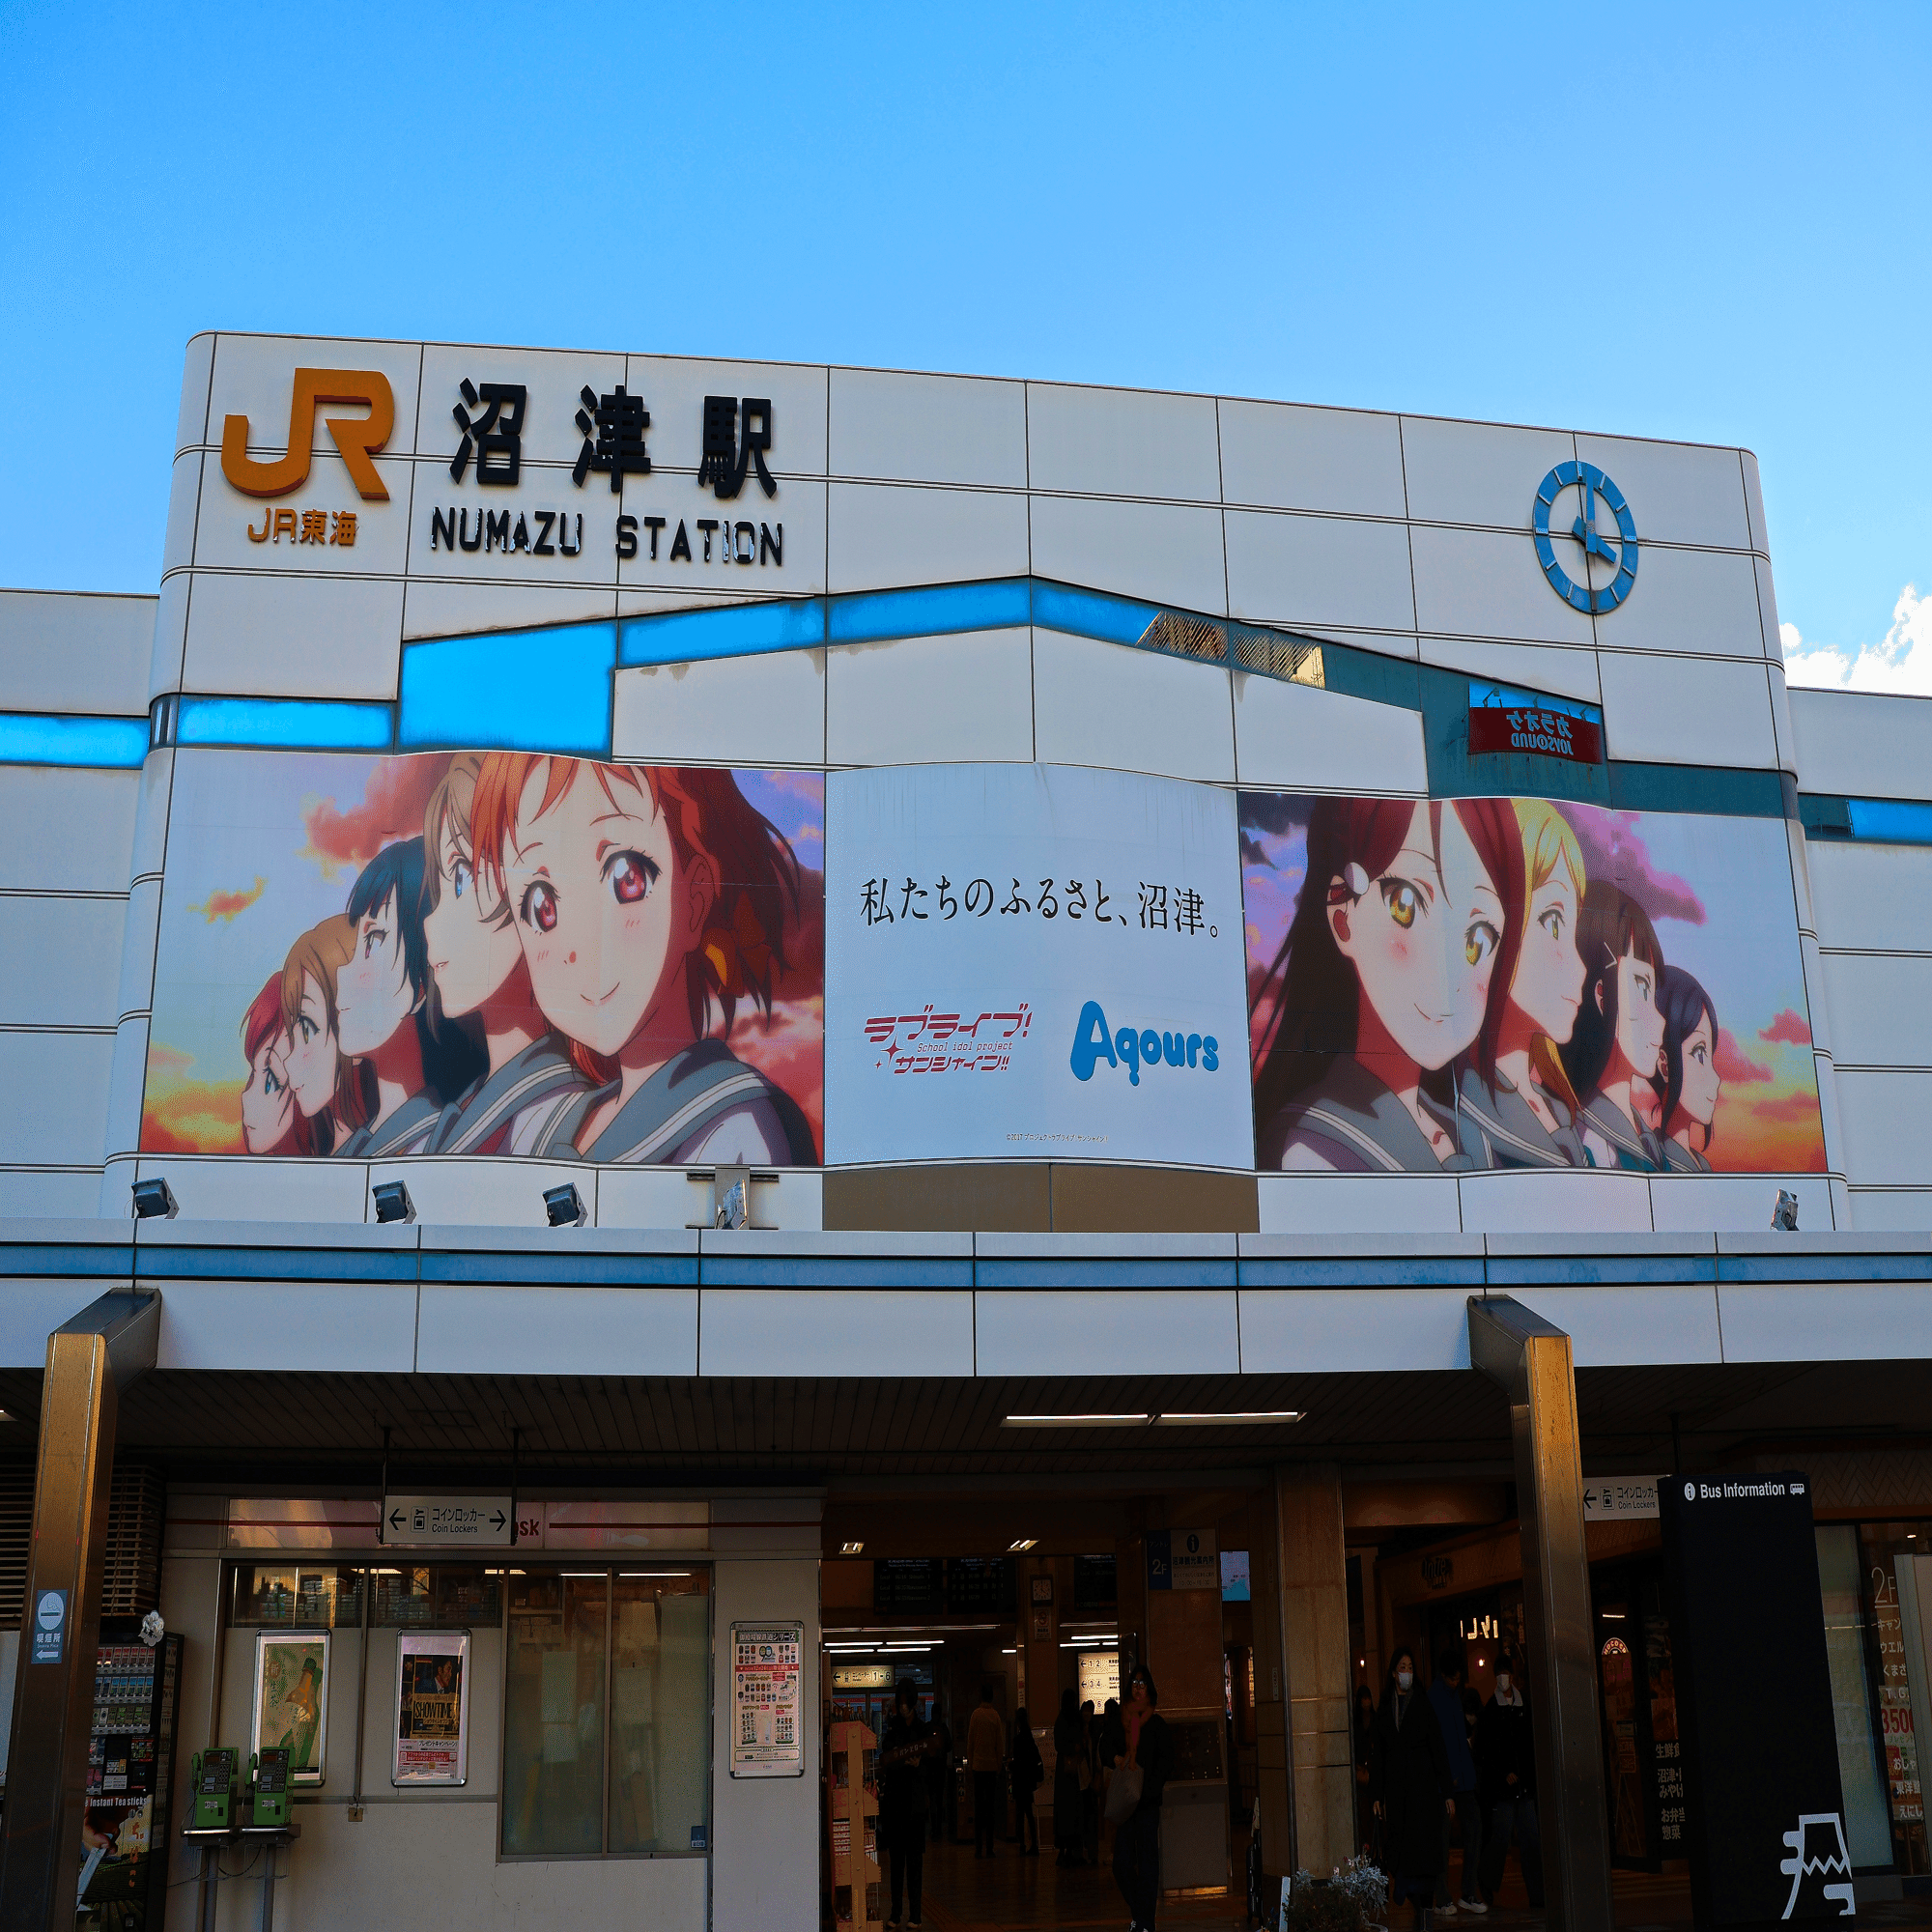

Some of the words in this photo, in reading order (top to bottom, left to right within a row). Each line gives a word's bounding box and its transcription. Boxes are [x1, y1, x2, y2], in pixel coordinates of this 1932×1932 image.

[221, 368, 394, 500] JR
[450, 378, 778, 498] 沼津駅
[247, 507, 357, 547] JR東海
[431, 506, 582, 556] NUMAZU
[615, 514, 783, 566] STATION
[860, 874, 1219, 939] 私たちのふるさと、沼津。
[917, 1040, 948, 1052] School
[952, 1040, 972, 1051] idol
[977, 1039, 1013, 1053] project
[1070, 1000, 1219, 1087] Aqours
[1700, 1484, 1721, 1498] Bus
[1724, 1481, 1785, 1497] Information
[1618, 1500, 1632, 1510] Coin
[1634, 1500, 1656, 1509] Lockers
[432, 1507, 486, 1522] コインロッカー
[432, 1523, 448, 1533] Coin
[450, 1524, 478, 1533] Lockers
[1151, 1558, 1167, 1576] 2F
[1871, 1567, 1896, 1604] 2F
[415, 1701, 452, 1719] SHOWTIME
[90, 1799, 114, 1807] Instant
[115, 1797, 126, 1806] Tea
[127, 1796, 147, 1806] sticks
